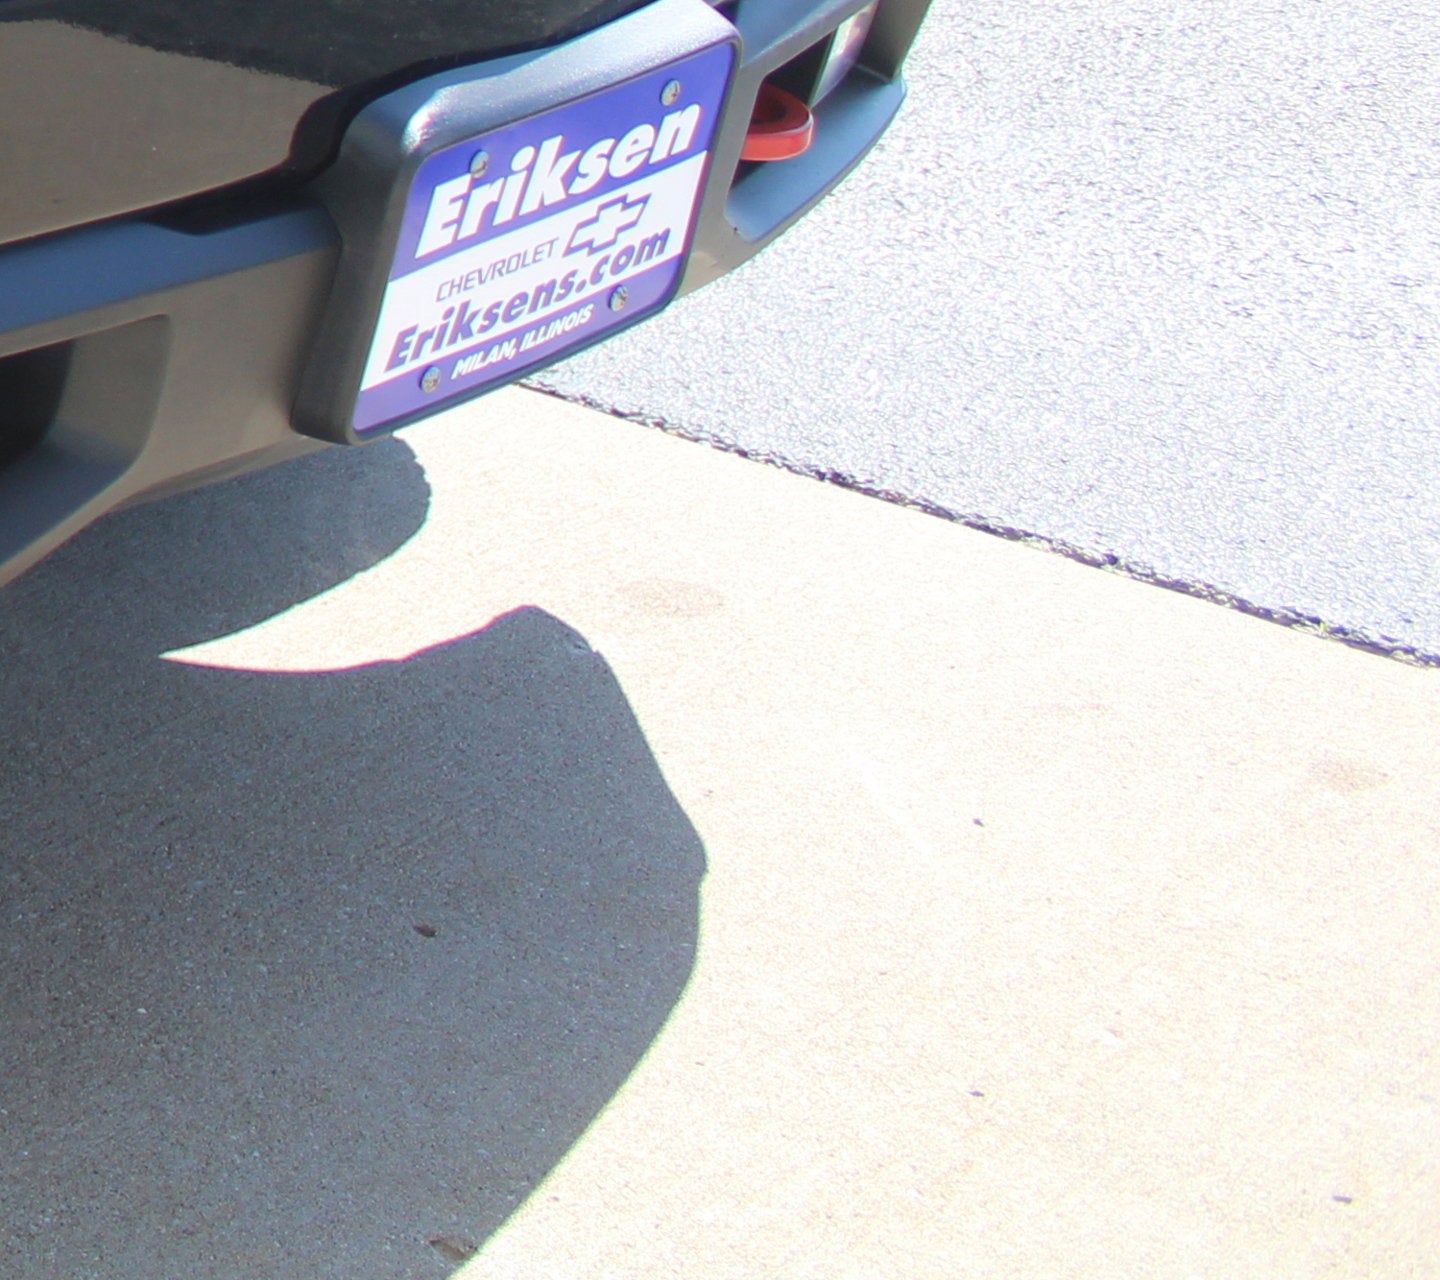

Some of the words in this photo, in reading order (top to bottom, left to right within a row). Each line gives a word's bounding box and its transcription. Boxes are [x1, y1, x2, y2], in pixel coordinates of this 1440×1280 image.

[414, 102, 702, 259] Eriksen
[384, 226, 672, 374] Eriksens.com
[435, 237, 559, 303] CHEVROLET
[451, 337, 517, 381] MILAN,
[519, 303, 595, 353] ILLINOIS
